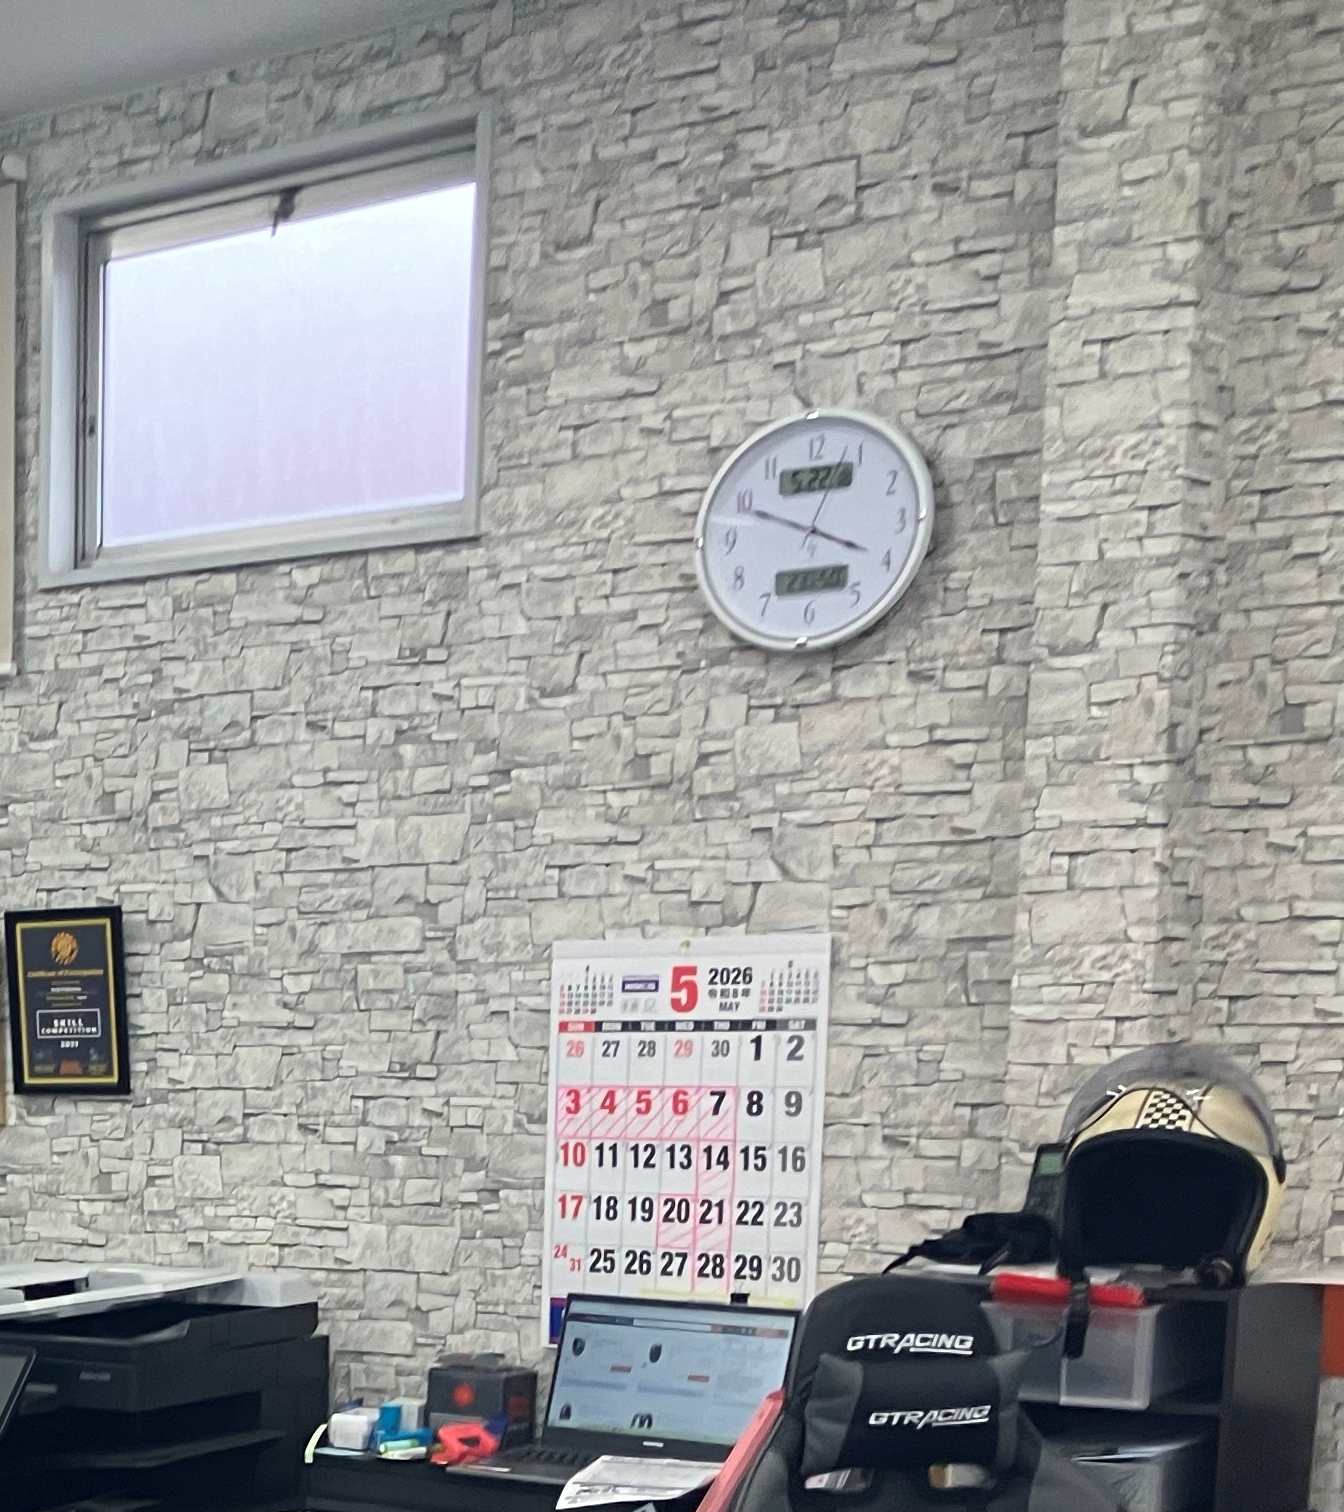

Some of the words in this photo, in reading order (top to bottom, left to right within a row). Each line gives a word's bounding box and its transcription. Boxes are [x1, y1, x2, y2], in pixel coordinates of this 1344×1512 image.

[809, 434, 824, 460] 12
[858, 441, 863, 463] 1
[765, 457, 777, 480] 11
[886, 470, 897, 495] 2
[737, 489, 753, 513] 10
[896, 507, 906, 534] 3
[726, 527, 737, 555] 9
[881, 550, 891, 572] 4
[733, 566, 744, 590] 8
[760, 593, 770, 616] 7
[849, 583, 860, 607] 5
[804, 601, 814, 624] 6
[708, 966, 753, 986] 2026
[670, 965, 699, 1013] 5
[719, 1002, 740, 1013] MAY
[567, 1042, 585, 1059] 26
[602, 1040, 620, 1058] 27
[638, 1040, 656, 1058] 28
[674, 1040, 693, 1058] 29
[711, 1040, 730, 1058] 30
[751, 1035, 761, 1061] 1
[786, 1035, 804, 1061] 2
[566, 1089, 581, 1114] 3
[600, 1090, 617, 1114] 4
[635, 1091, 652, 1115] 5
[672, 1090, 689, 1115] 6
[710, 1091, 726, 1116] 7
[746, 1090, 764, 1116] 8
[784, 1091, 803, 1117] 9
[560, 1142, 586, 1167] 10
[595, 1143, 618, 1168] 11
[630, 1143, 656, 1168] 12
[666, 1144, 692, 1169] 13
[703, 1144, 730, 1171] 14
[740, 1145, 767, 1171] 15
[778, 1146, 806, 1172] 16
[558, 1195, 584, 1219] 17
[593, 1195, 618, 1221] 18
[628, 1196, 654, 1222] 19
[663, 1198, 690, 1223] 20
[699, 1199, 724, 1225] 21
[736, 1200, 764, 1226] 22
[774, 1201, 802, 1227] 23
[553, 1244, 568, 1258] 24
[570, 1258, 581, 1272] 31
[589, 1248, 615, 1273] 25
[624, 1250, 652, 1275] 26
[660, 1251, 688, 1276] 27
[697, 1253, 725, 1278] 28
[734, 1254, 762, 1280] 29
[771, 1256, 801, 1282] 30
[846, 1332, 974, 1355] GTRACING
[869, 1405, 991, 1429] GTRACING
